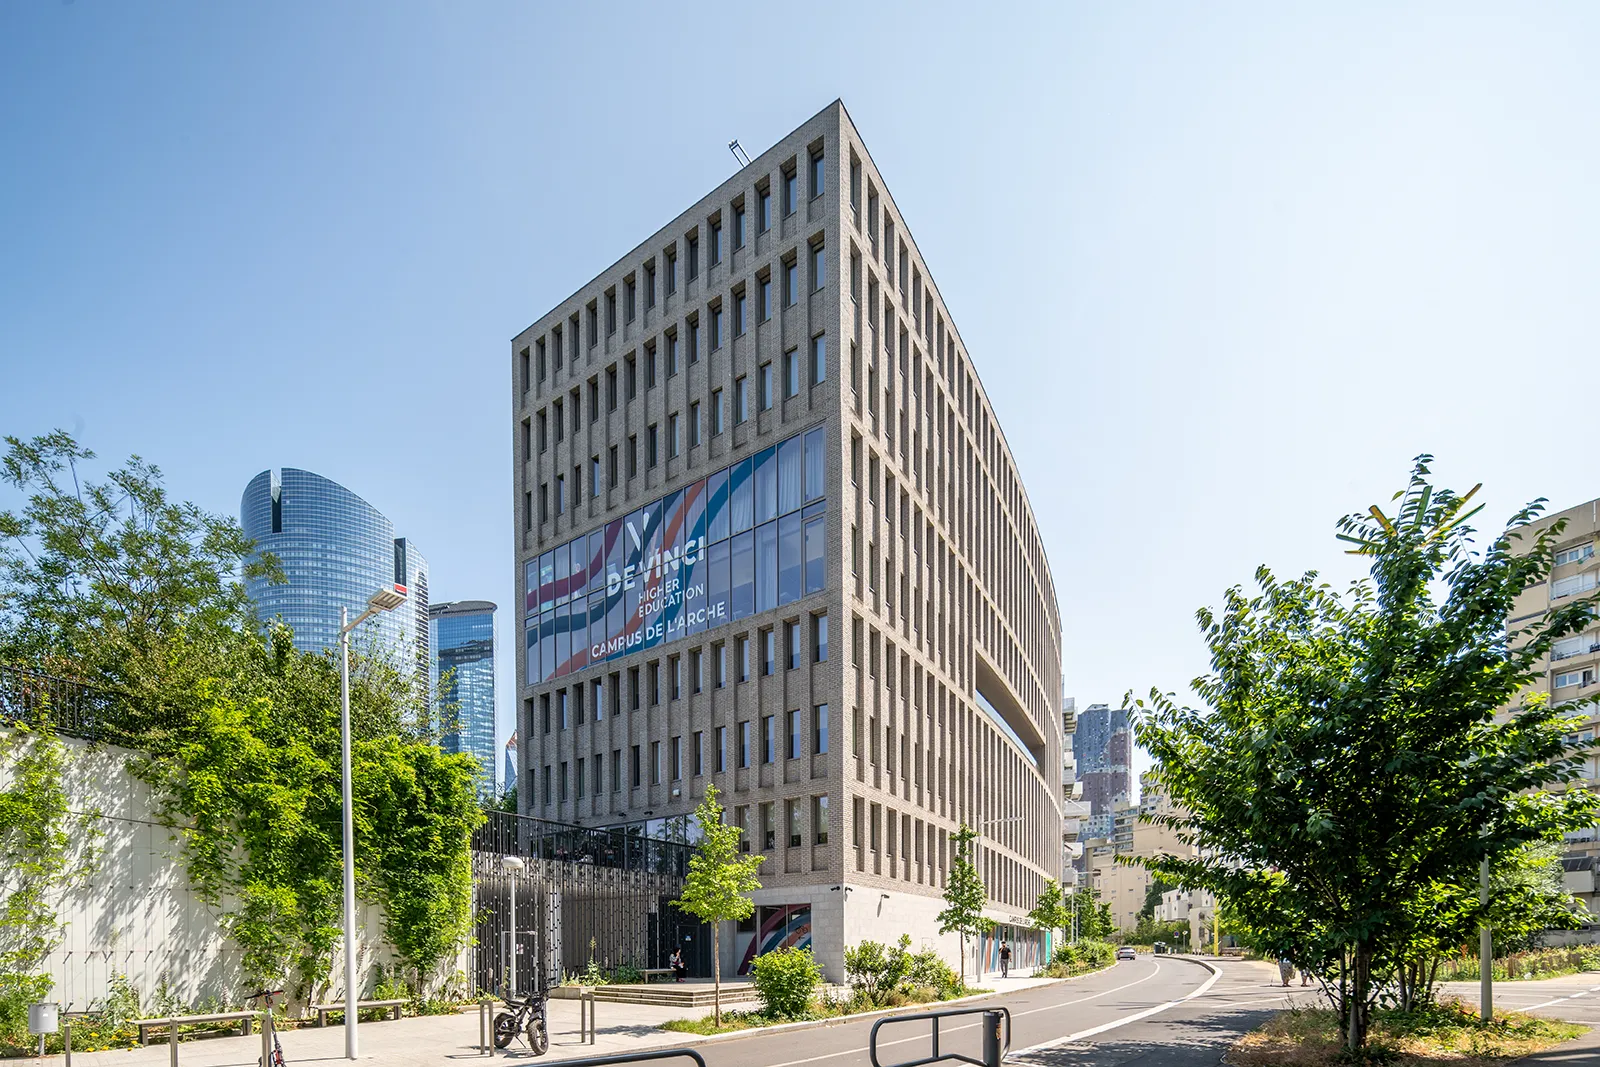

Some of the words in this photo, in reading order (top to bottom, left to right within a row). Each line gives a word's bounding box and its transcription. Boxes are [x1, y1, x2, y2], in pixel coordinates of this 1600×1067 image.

[639, 536, 704, 582] VINCI
[638, 578, 680, 604] HIGHER
[639, 584, 703, 618] EDUCATION
[591, 632, 642, 658] CAMPUS
[646, 622, 663, 640] DE
[667, 601, 725, 633] L'ARCHE
